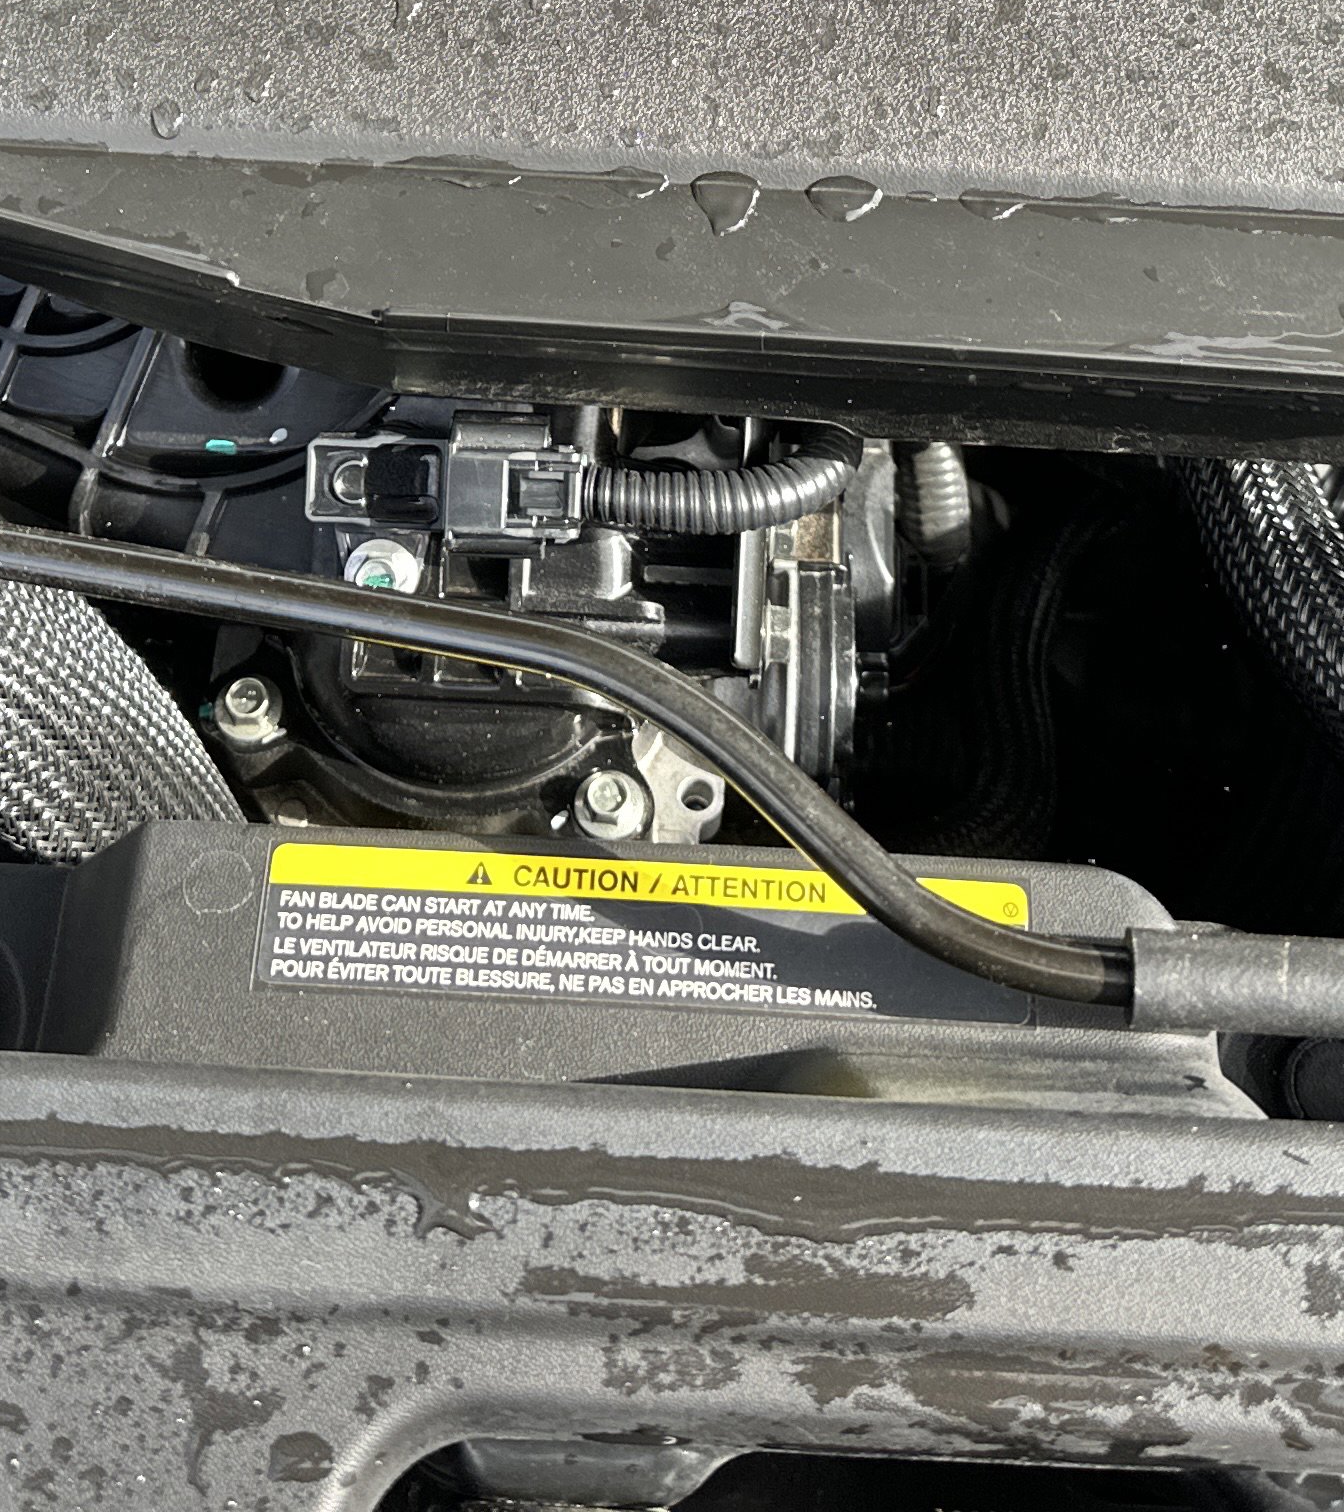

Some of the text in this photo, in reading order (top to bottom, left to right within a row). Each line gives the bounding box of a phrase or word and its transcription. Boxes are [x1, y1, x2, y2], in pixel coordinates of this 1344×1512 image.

[513, 864, 826, 904] CAUTION / ATTENTION
[279, 889, 596, 923] FAN BLADE CAN START AT ANY TIME.
[278, 911, 302, 930] TO
[306, 912, 353, 932] HELP
[356, 915, 412, 935] AVOID
[415, 919, 512, 940] PERSONAL
[628, 929, 692, 951] HANDS
[697, 933, 760, 953] CLEAR.
[273, 937, 778, 980] LE VENTILATEUR RISQUE DE DÉMARRER À TOUT MOMENT.
[270, 957, 877, 1009] POUR ÉVITER TOUTE BLESSURE, NE PAS EN APPROCHER LES MAINS.
